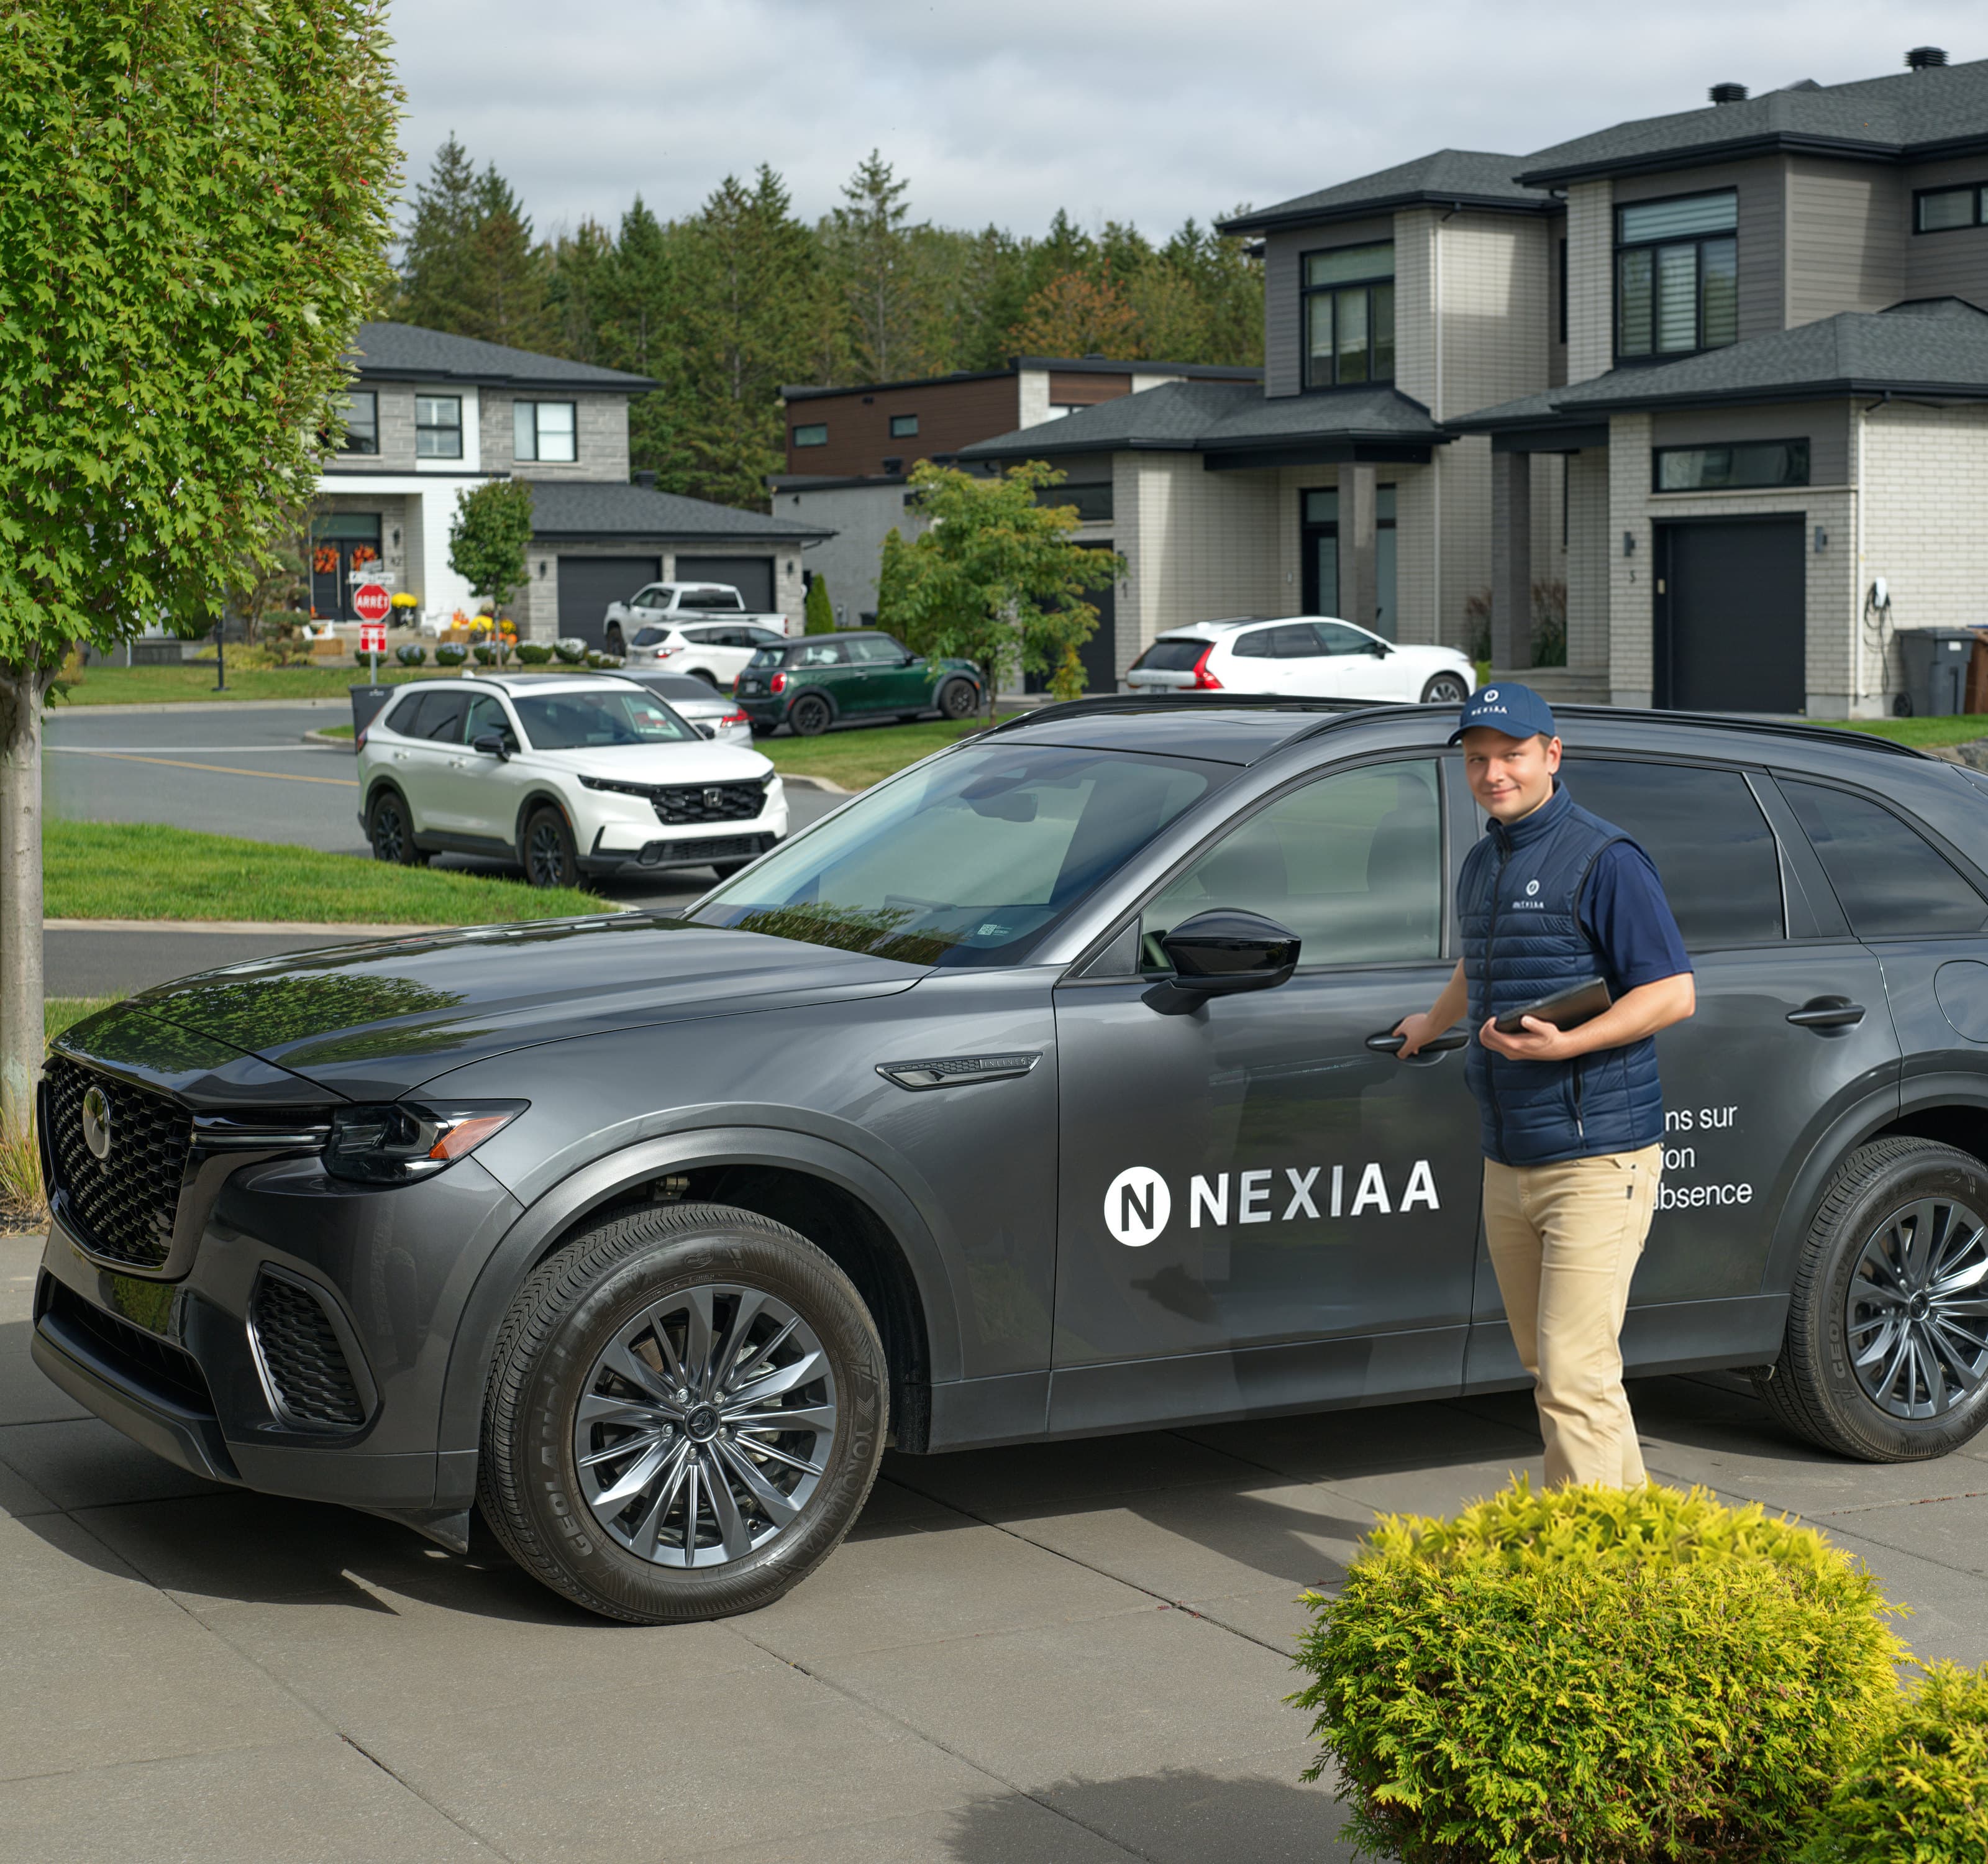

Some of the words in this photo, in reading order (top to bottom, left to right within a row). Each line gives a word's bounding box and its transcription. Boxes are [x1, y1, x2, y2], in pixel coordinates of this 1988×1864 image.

[357, 593, 388, 609] ARRÊT
[1699, 1105, 1738, 1130] sur
[1121, 1181, 1155, 1233] N
[1189, 1159, 1441, 1229] NEXIAA
[798, 1426, 873, 1553] YOKOHAMA
